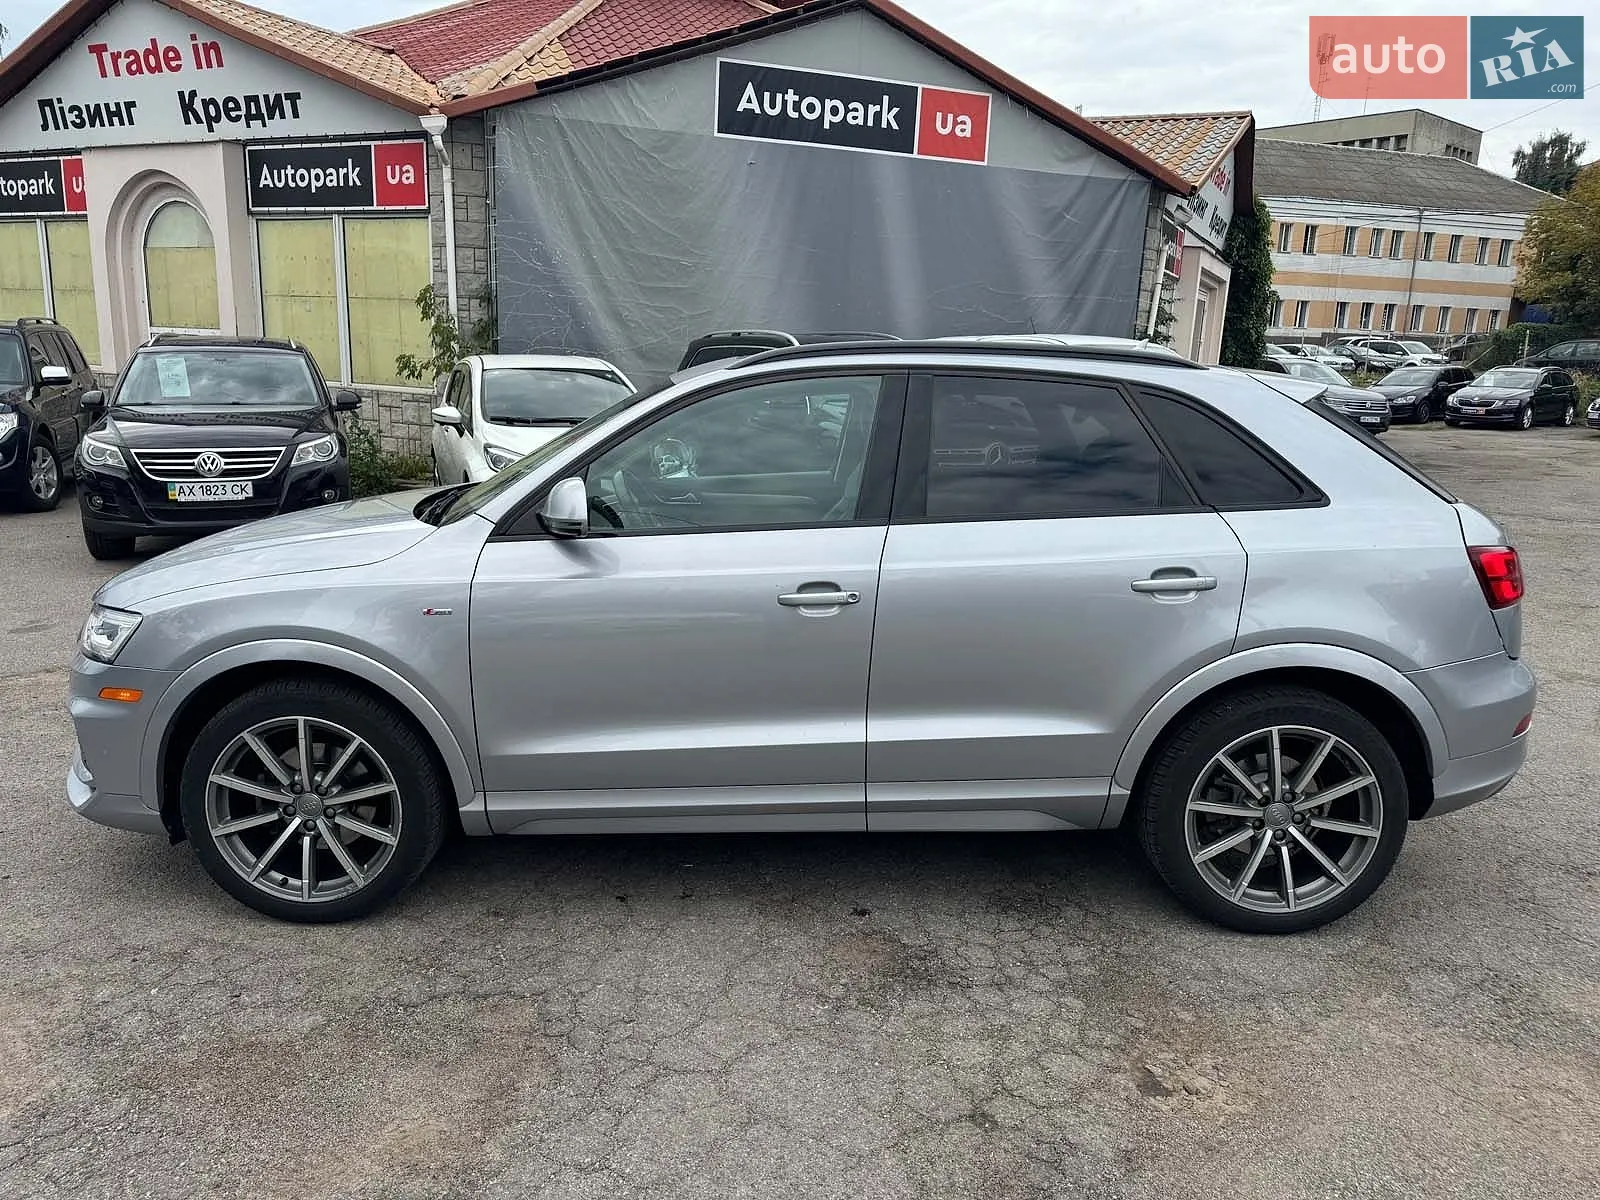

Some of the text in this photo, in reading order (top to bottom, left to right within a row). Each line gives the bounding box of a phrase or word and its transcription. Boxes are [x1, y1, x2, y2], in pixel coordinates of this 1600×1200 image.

[88, 33, 224, 79] Trade in
[37, 88, 302, 133] Лізинг Кредит
[736, 81, 972, 138] Autopark ua
[258, 158, 416, 194] Autopark ua
[177, 482, 249, 497] AX 1823 CK
